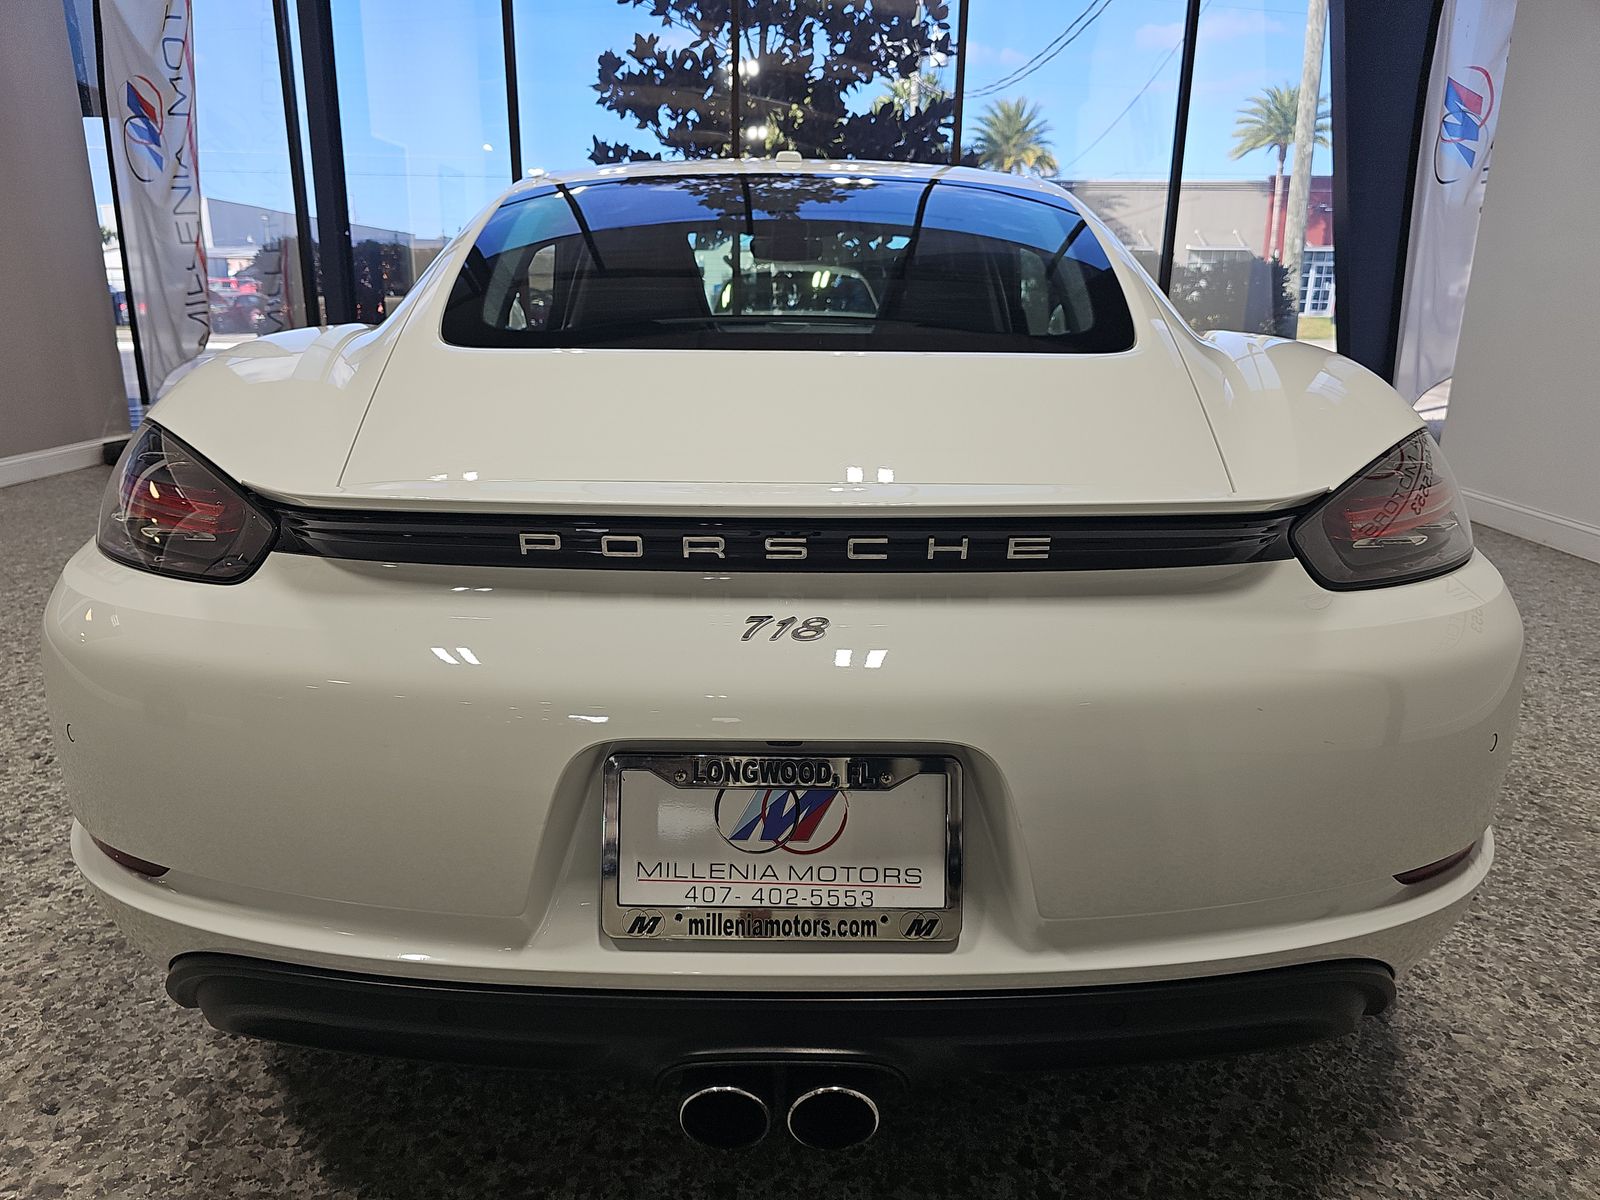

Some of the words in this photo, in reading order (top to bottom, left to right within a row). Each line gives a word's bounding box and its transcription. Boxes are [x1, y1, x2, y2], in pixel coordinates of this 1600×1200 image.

[518, 532, 1053, 561] PORSCHE
[740, 614, 832, 642] 718
[692, 758, 841, 788] LONGWOOD,
[847, 760, 877, 785] FL
[636, 861, 780, 881] MILLENIA
[788, 865, 923, 885] MOTORS
[688, 912, 878, 937] milleniamotors.com
